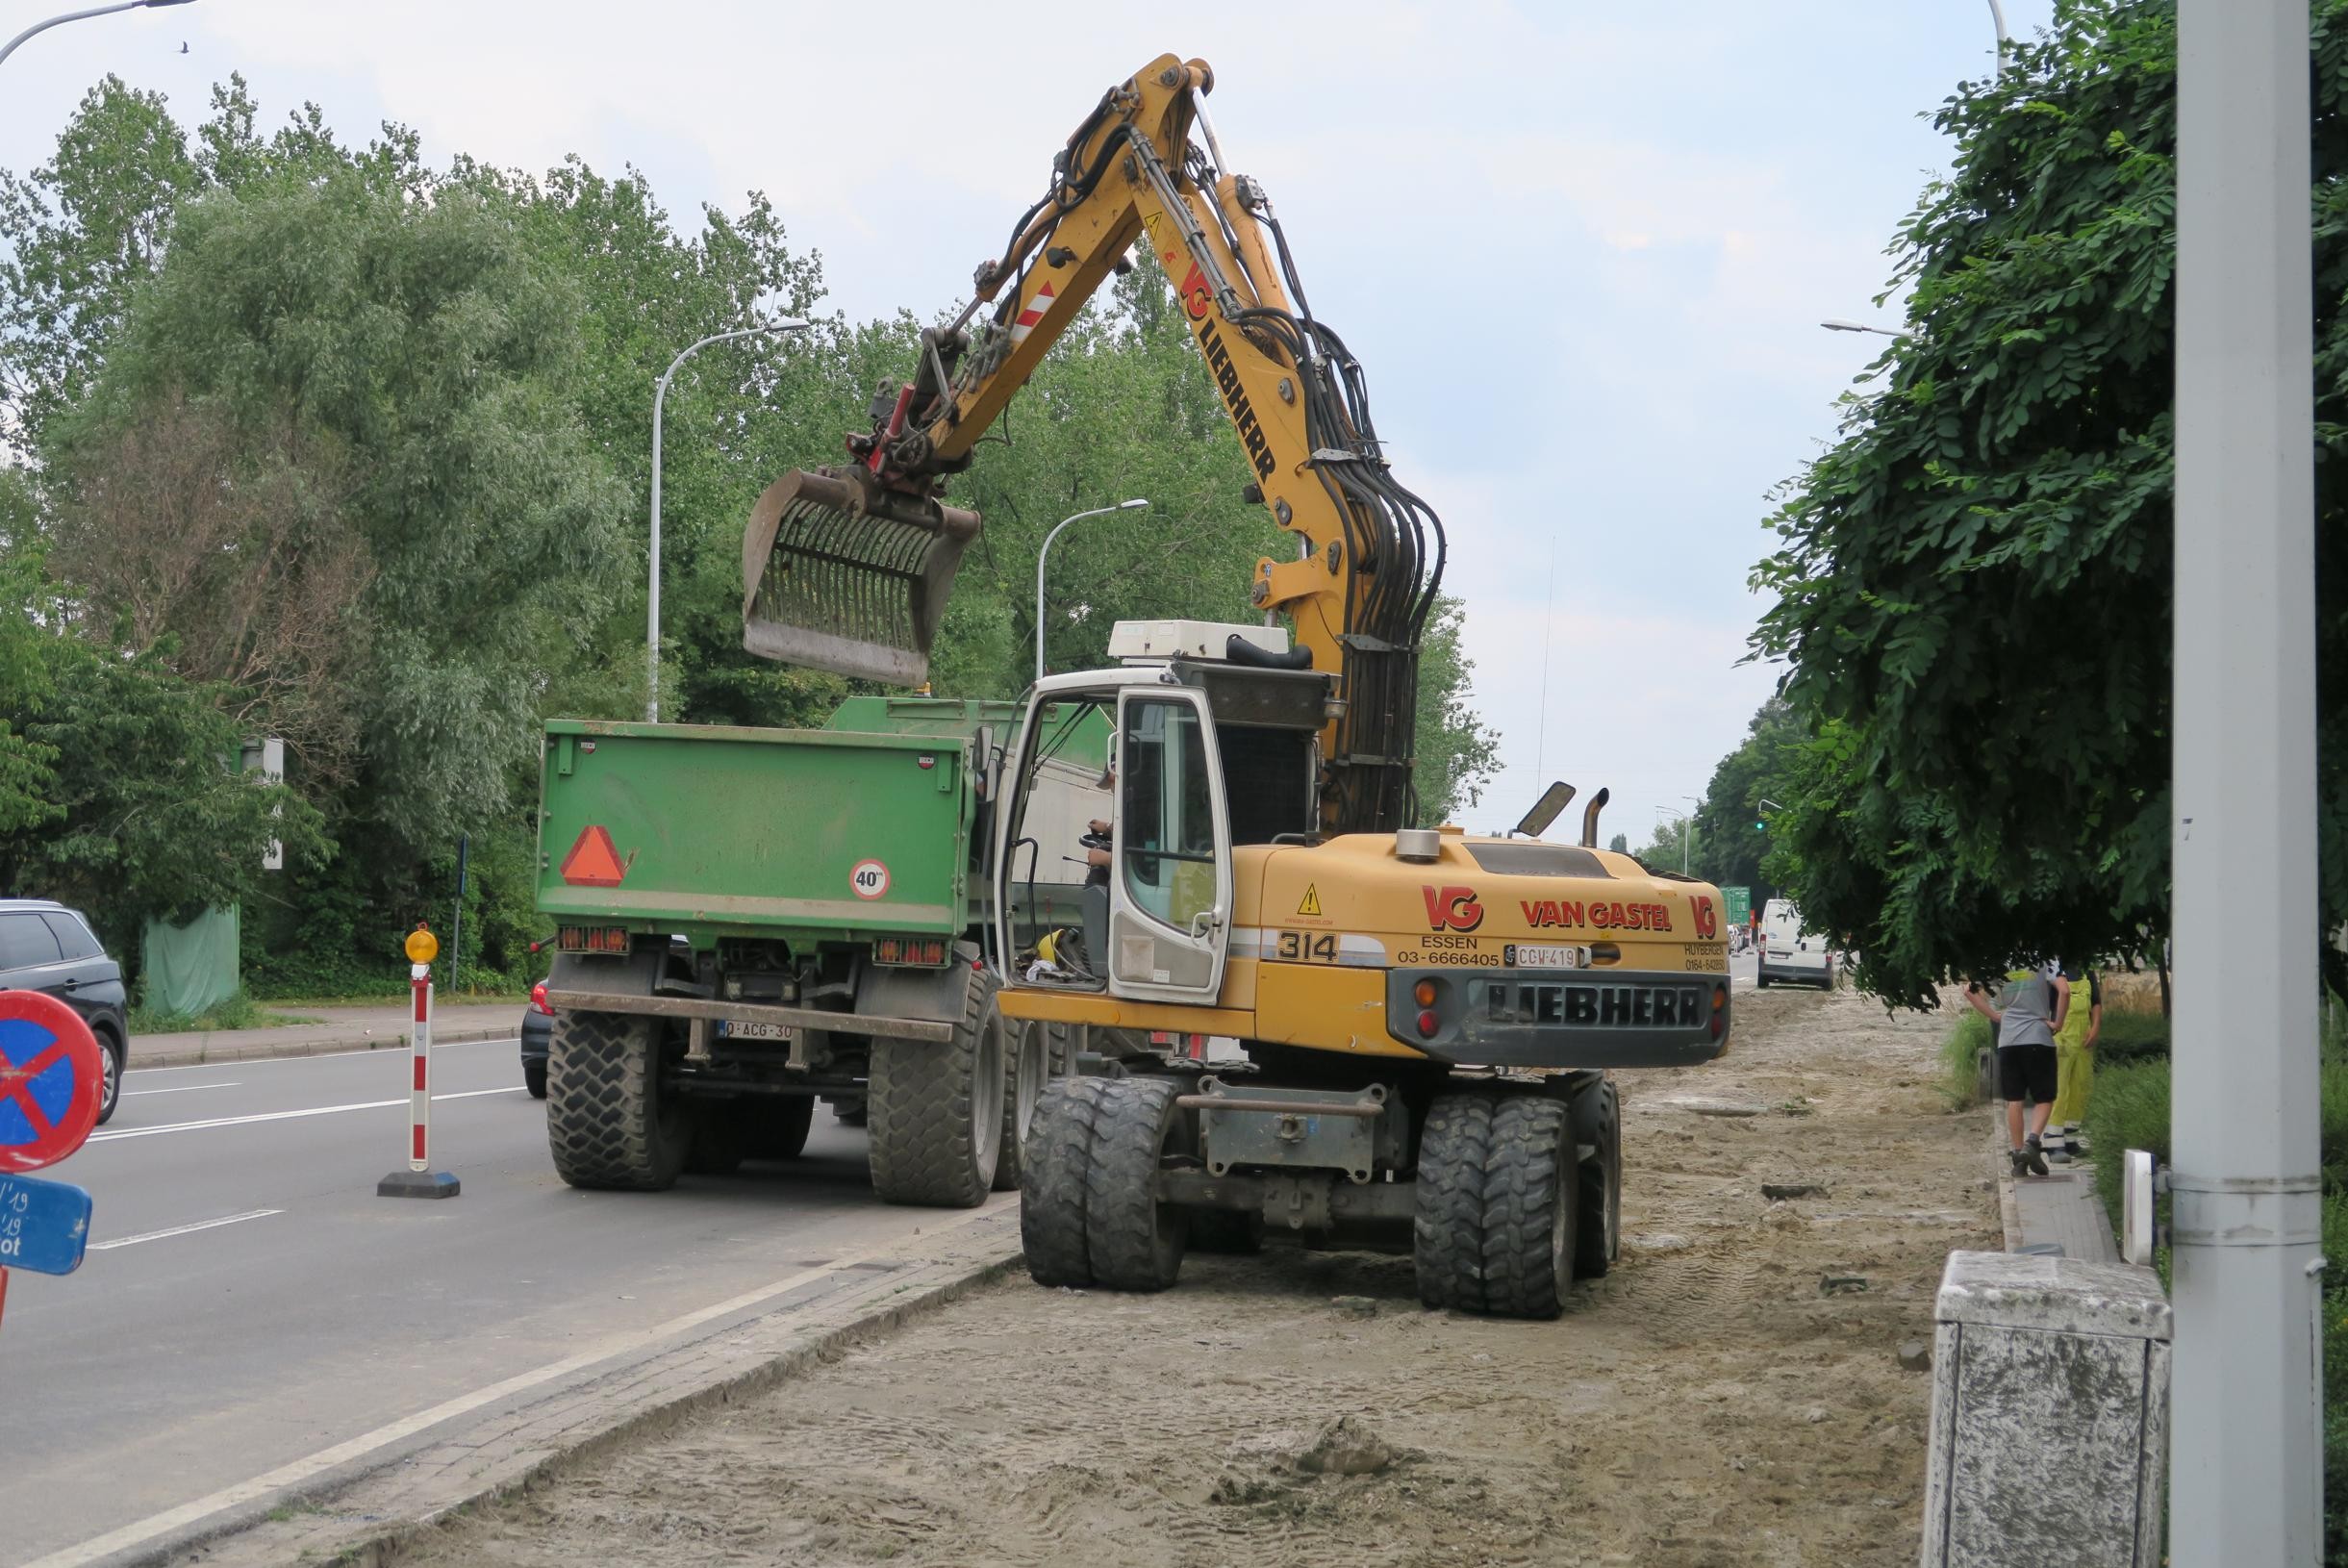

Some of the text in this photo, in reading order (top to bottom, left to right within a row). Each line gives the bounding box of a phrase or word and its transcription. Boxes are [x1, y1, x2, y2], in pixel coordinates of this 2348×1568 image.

[1199, 316, 1275, 485] LIEBHERR
[856, 871, 876, 887] 40
[1422, 884, 1484, 933] VG
[1520, 900, 1672, 931] VAN GASTEL
[1689, 896, 1716, 940] VG
[1278, 930, 1338, 963] 314
[1398, 950, 1499, 966] 03-6666405
[1422, 936, 1477, 949] ESSEN
[1488, 984, 1702, 1026] LIEBHERR
[0, 1237, 20, 1256] ot
